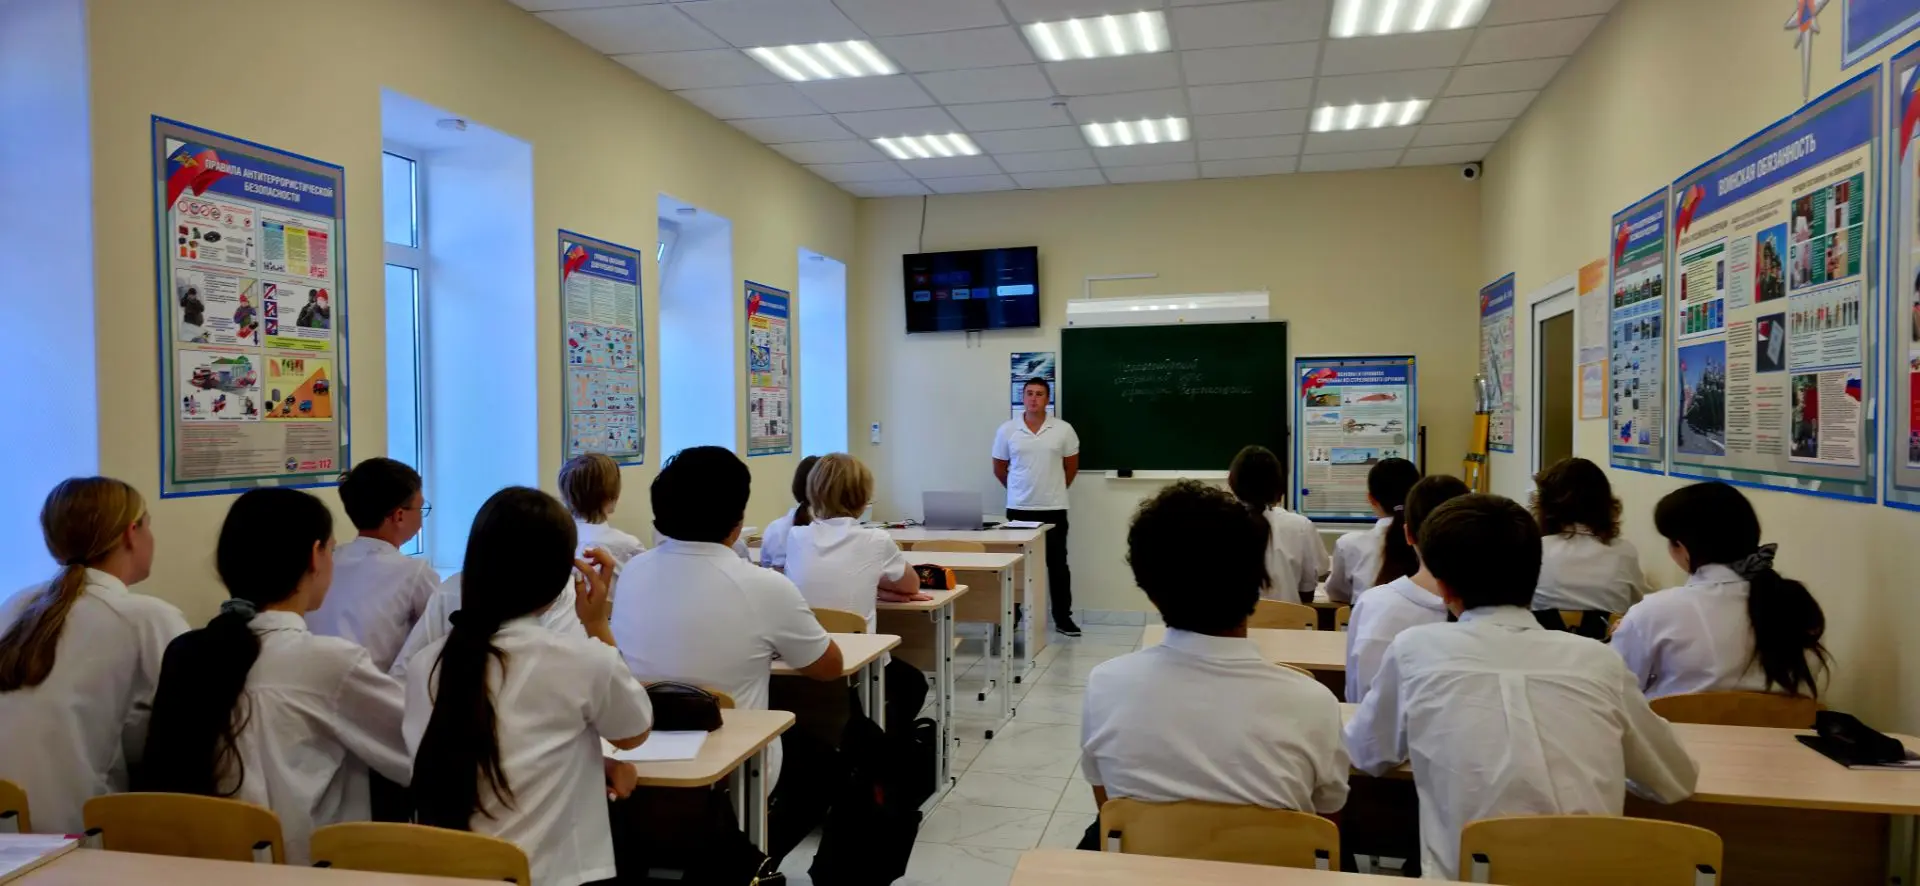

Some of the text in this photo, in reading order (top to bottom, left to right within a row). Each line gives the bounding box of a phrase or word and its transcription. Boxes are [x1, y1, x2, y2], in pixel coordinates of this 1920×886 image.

[205, 159, 333, 197] ПРАВИЛА АНТИТЕРРОРИСТИЧЕСКОЙ
[1718, 163, 1756, 196] ВОИНСКАЯ
[1757, 133, 1816, 178] ОБЯЗАННОСТЬ
[244, 182, 300, 202] БЕЗОПАСНОСТИ
[319, 459, 332, 469] 112
